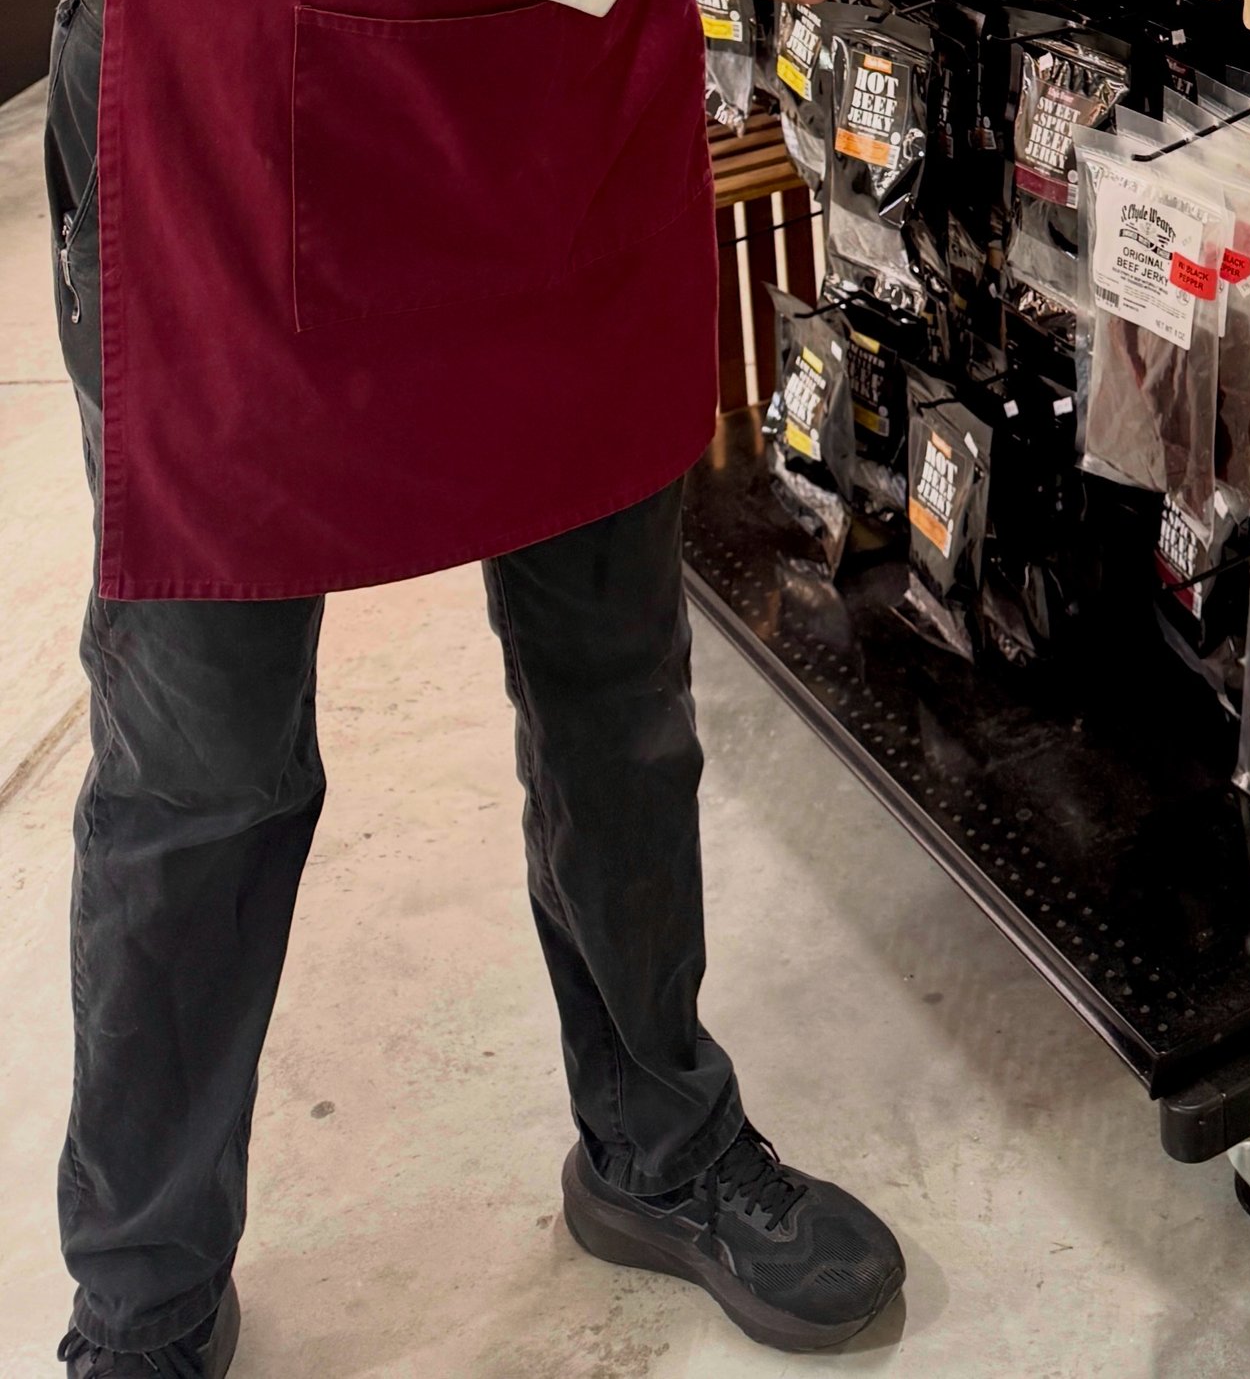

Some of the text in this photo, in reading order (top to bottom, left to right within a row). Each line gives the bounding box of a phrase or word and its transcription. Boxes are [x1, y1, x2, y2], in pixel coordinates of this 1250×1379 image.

[855, 66, 899, 98] HOT
[851, 88, 898, 118] BEEF
[1036, 96, 1081, 123] SWEET
[847, 107, 895, 132] JERKY
[1030, 122, 1072, 155] BEEF
[1024, 140, 1068, 169] JERKY
[1117, 256, 1170, 288] BEEF JERKY
[1122, 246, 1166, 272] ORIGINAL
[1186, 263, 1210, 282] BLACK
[1178, 272, 1205, 292] PEPPER
